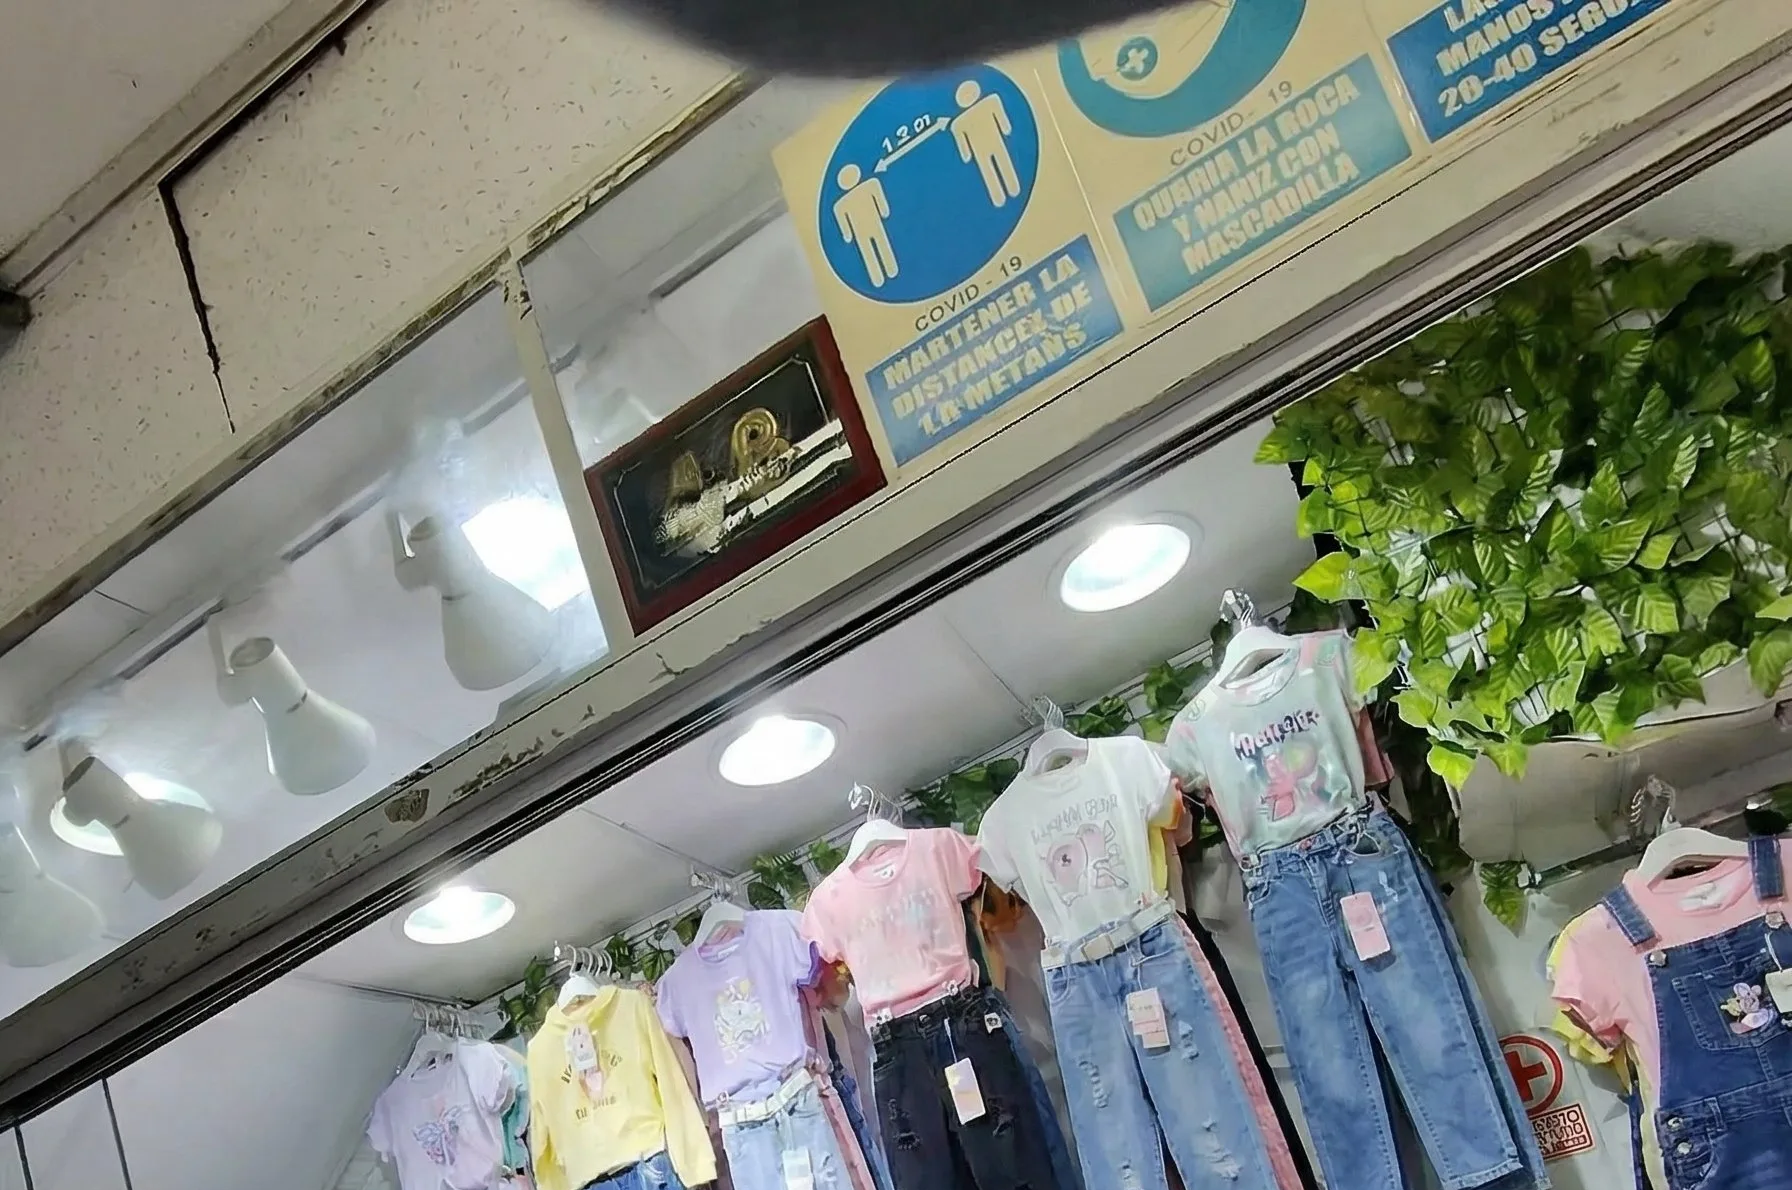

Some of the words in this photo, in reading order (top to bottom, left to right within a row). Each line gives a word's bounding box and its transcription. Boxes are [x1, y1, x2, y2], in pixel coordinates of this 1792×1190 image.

[1267, 80, 1293, 105] 19
[1237, 126, 1278, 167] LA
[1172, 214, 1192, 243] Y
[1276, 121, 1341, 180] CON
[1038, 254, 1081, 293] LA
[914, 284, 980, 333] COVID
[999, 256, 1023, 279] 19
